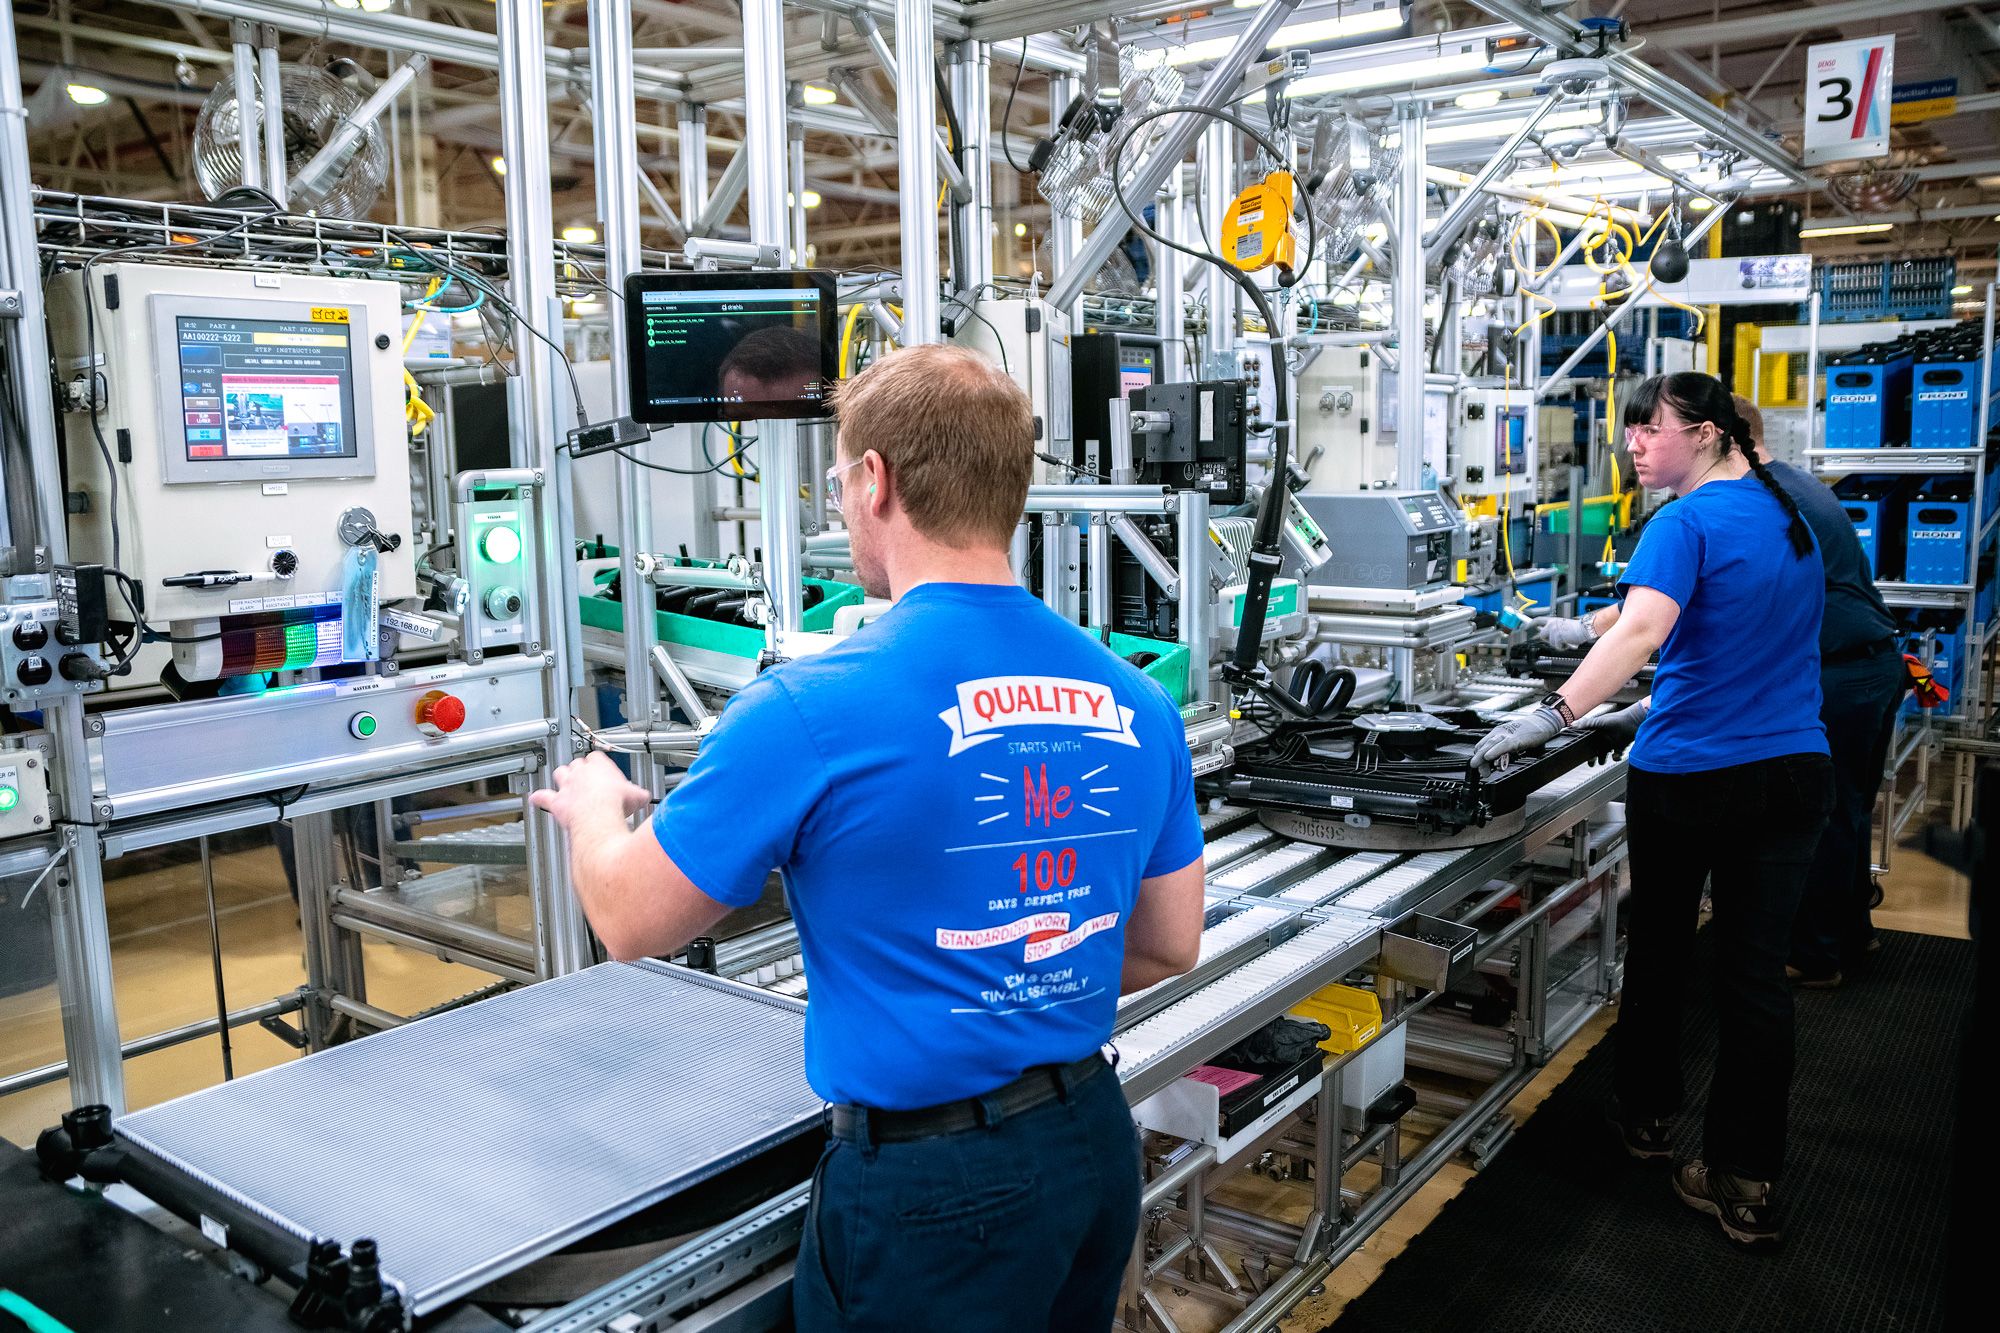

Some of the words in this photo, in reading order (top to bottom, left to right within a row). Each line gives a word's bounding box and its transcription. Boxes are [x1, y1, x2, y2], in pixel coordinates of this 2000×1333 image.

[1817, 59, 1836, 69] DENSO
[1817, 77, 1854, 122] 3
[183, 332, 241, 342] AA100222-6222
[1832, 395, 1874, 403] FRONT
[1918, 391, 1967, 400] FRONT
[1913, 530, 1957, 539] FRONT
[23, 620, 39, 631] LIGHT
[386, 617, 433, 636] 192.168.0.021
[29, 657, 41, 666] FAN
[973, 685, 1105, 722] QUALITY
[1008, 741, 1049, 754] STARTS
[1051, 740, 1082, 753] WITH
[1023, 763, 1075, 828] Me
[1012, 848, 1077, 894] 100
[988, 897, 1018, 911] DAYS
[1024, 892, 1064, 907] DEFECT
[1067, 885, 1092, 900] FREE
[941, 924, 1029, 947] STANDARDIZED
[1034, 915, 1068, 929] WORK
[1027, 942, 1052, 961] STOP
[1061, 931, 1081, 952] CALL
[1091, 913, 1117, 932] WAIT
[1041, 967, 1073, 983] OEM
